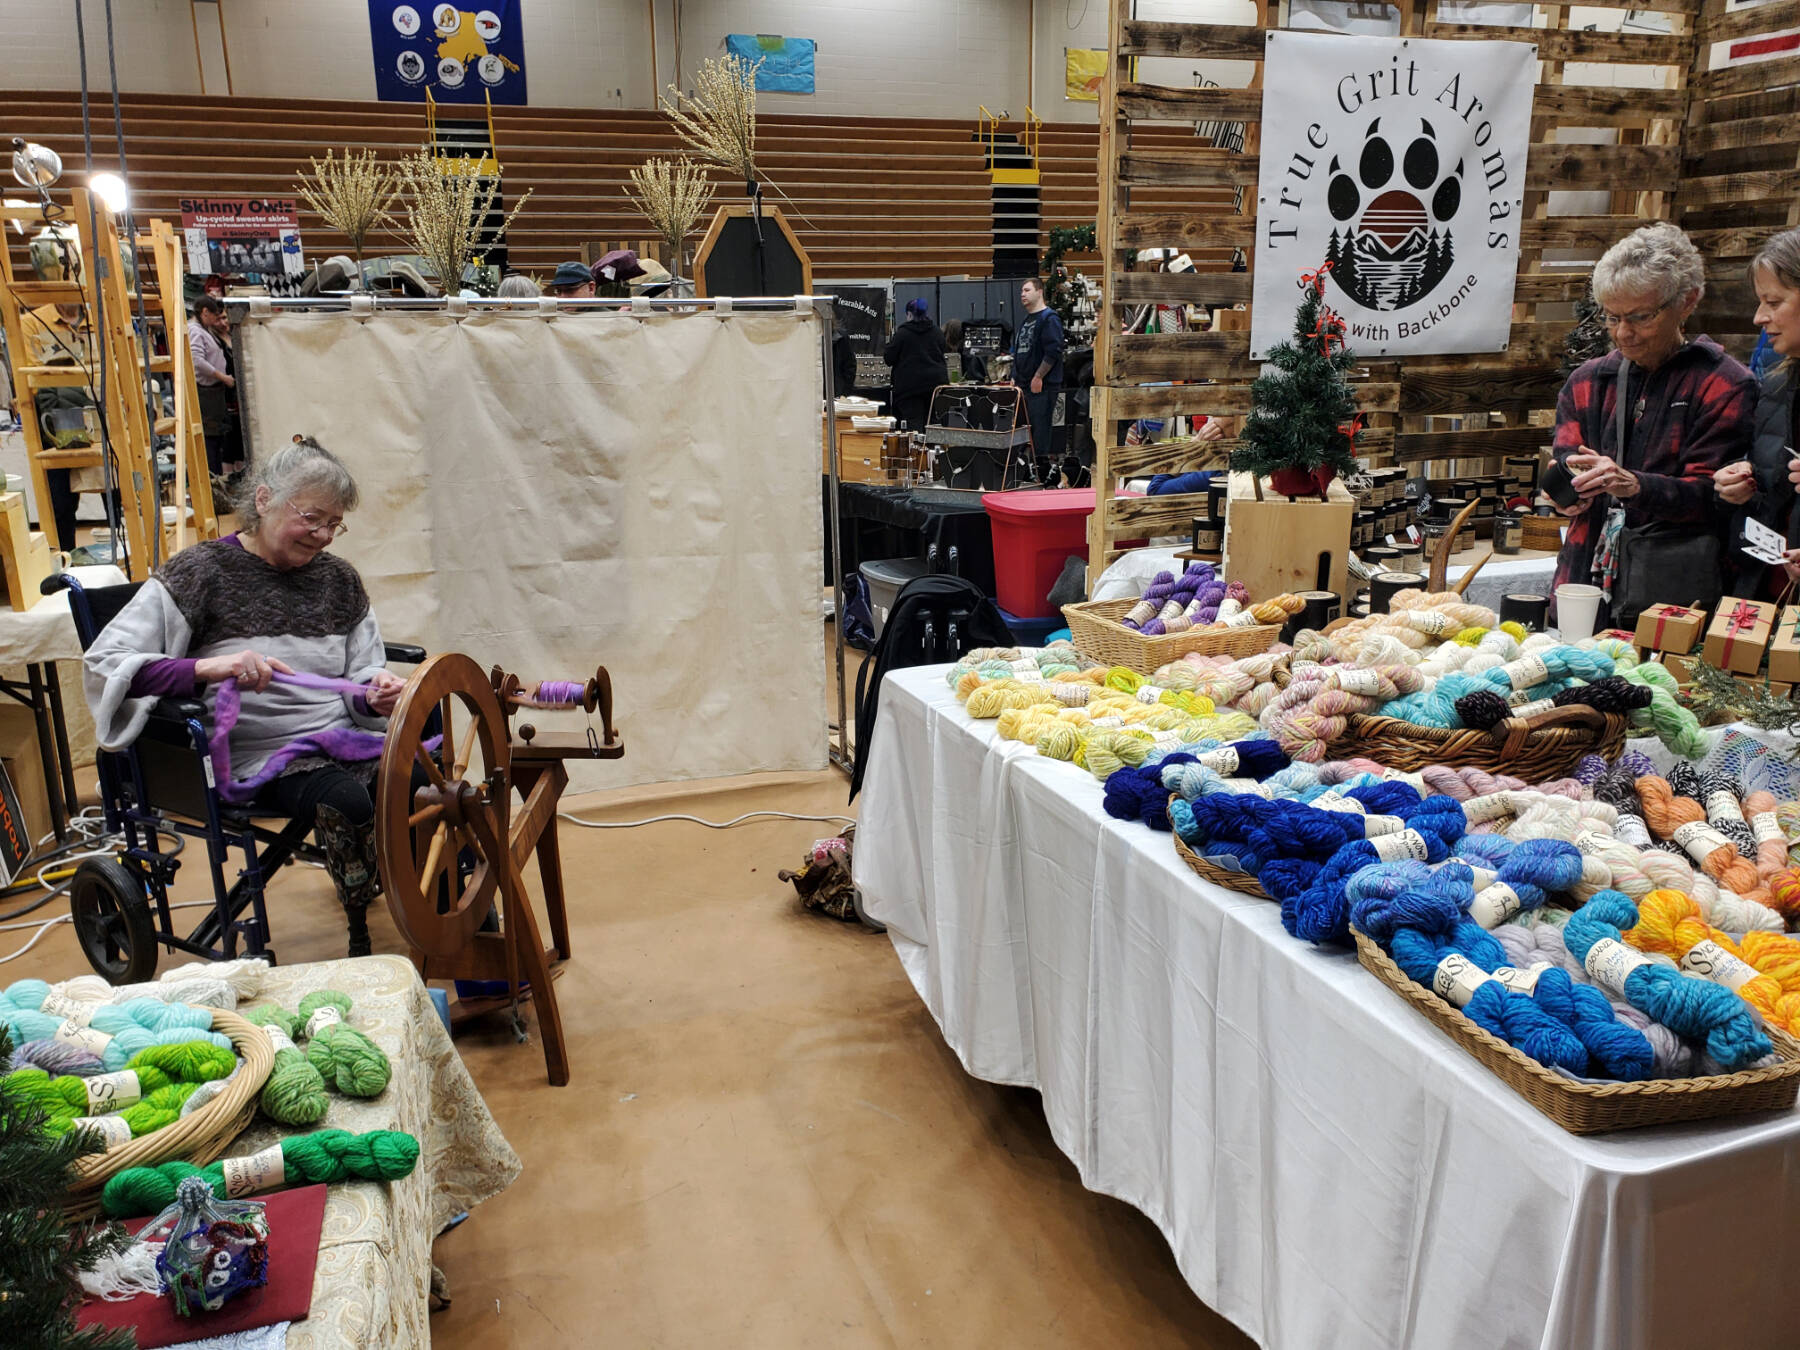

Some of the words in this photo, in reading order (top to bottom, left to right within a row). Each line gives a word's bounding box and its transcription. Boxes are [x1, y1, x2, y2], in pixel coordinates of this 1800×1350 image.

[1268, 122, 1329, 249] True
[1337, 56, 1420, 114] Grit
[1434, 71, 1512, 250] Aromas
[180, 199, 243, 216] Skinny
[195, 214, 235, 224] Up-cycled
[267, 213, 289, 223] skirts
[864, 305, 878, 318] Arts
[1351, 322, 1390, 342] with
[1397, 272, 1479, 340] Backbone
